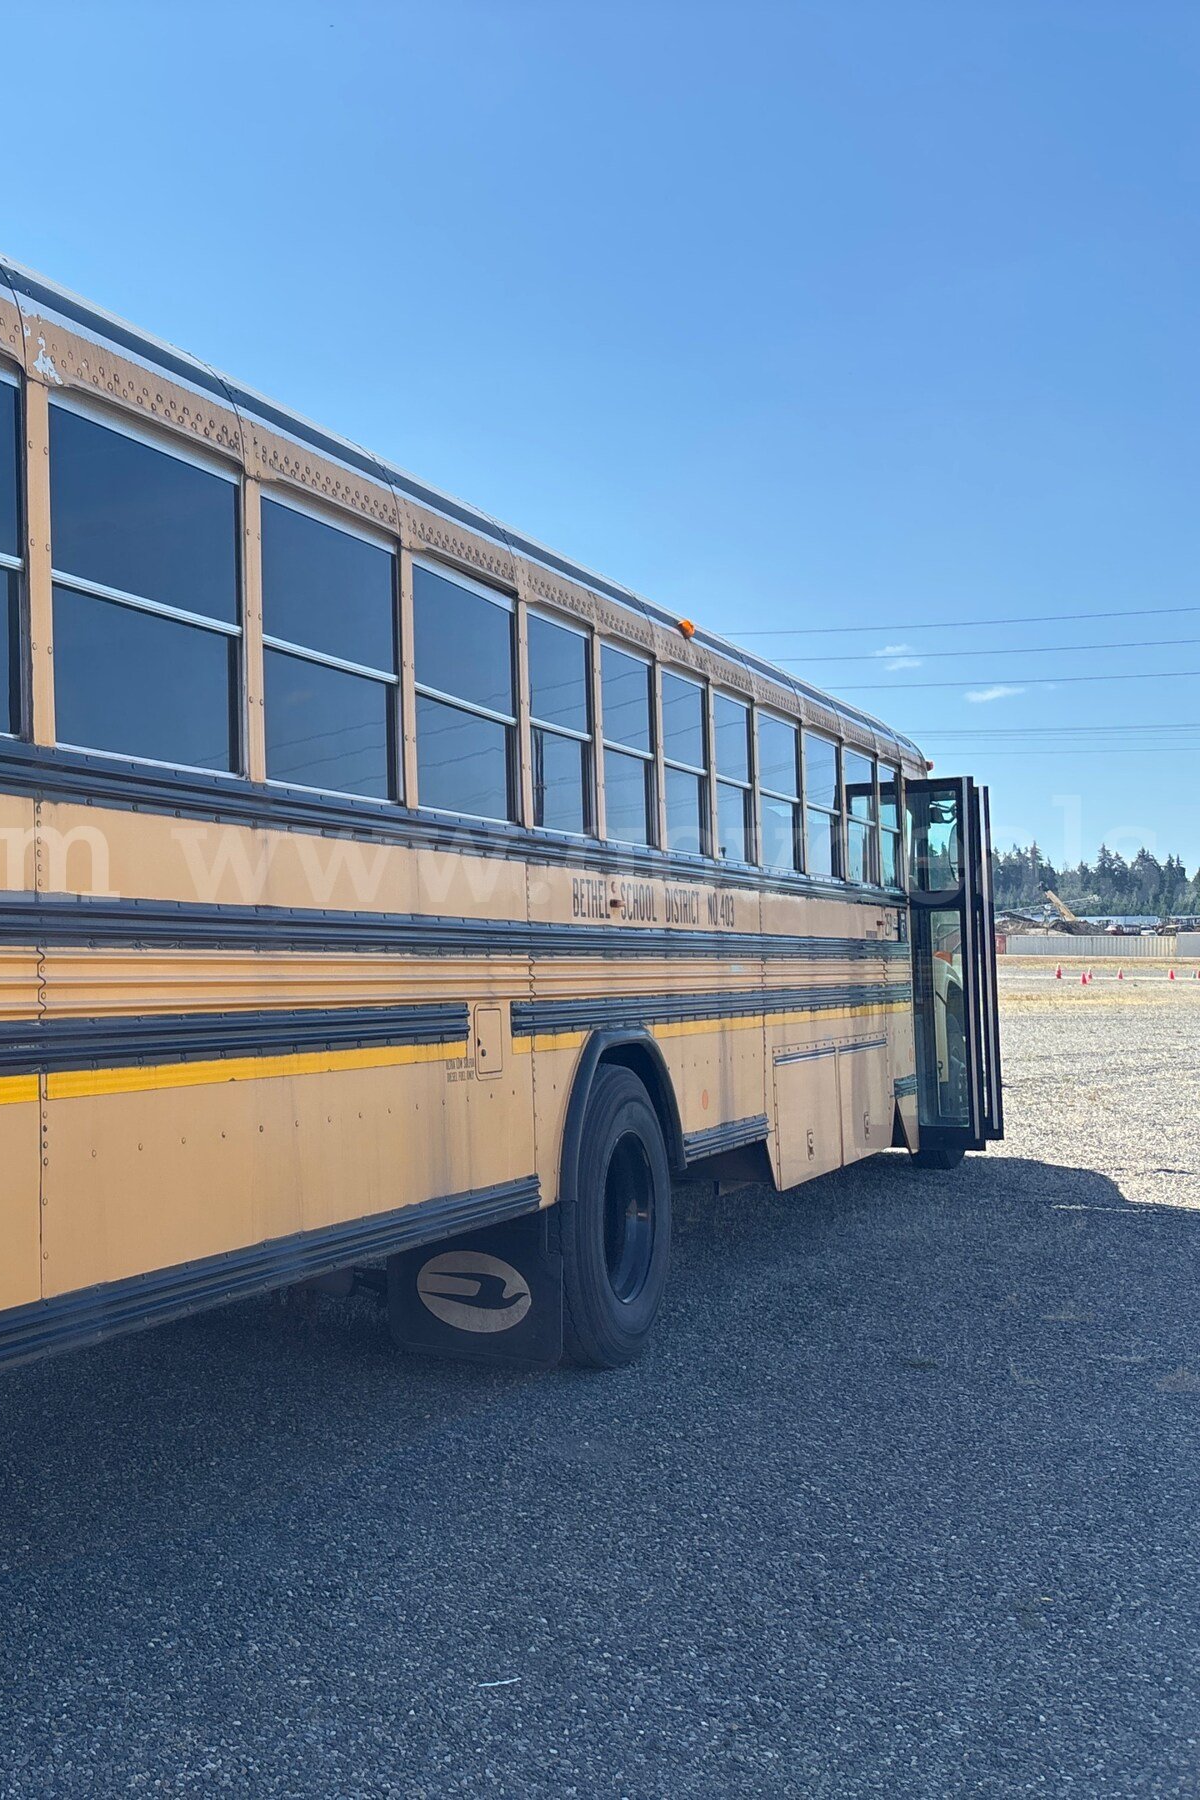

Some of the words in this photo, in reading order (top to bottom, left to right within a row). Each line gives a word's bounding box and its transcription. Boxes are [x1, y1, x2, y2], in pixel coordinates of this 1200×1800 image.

[572, 877, 611, 920] BETHEL
[620, 881, 658, 923] SCHOOL
[664, 887, 700, 925] DISTRICT
